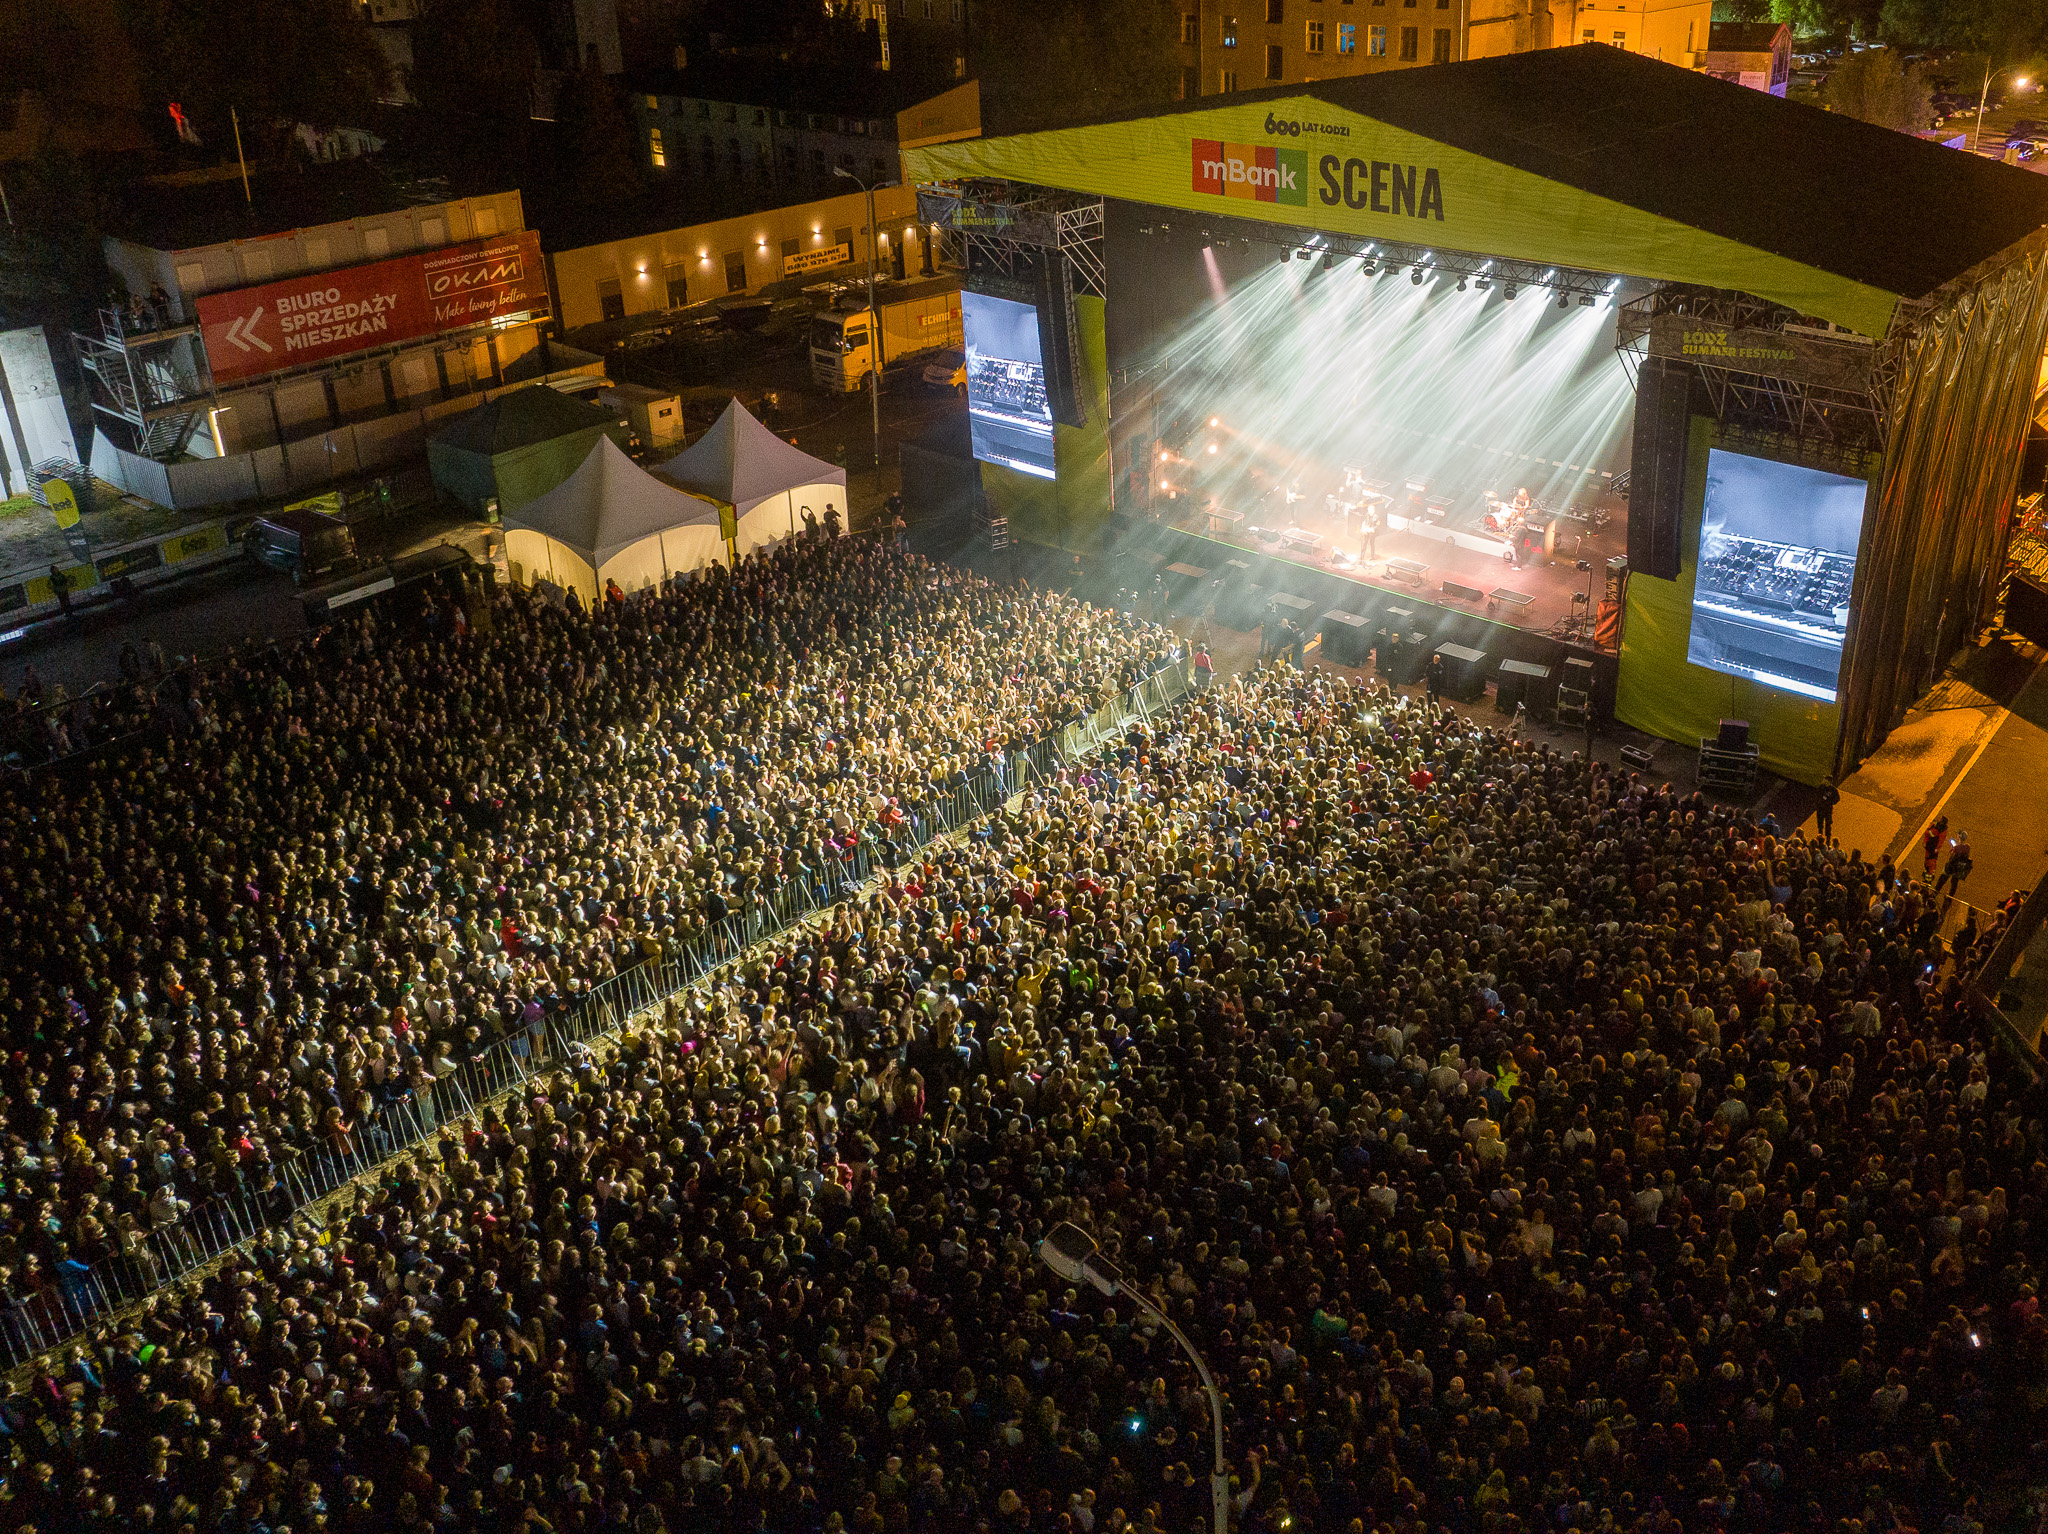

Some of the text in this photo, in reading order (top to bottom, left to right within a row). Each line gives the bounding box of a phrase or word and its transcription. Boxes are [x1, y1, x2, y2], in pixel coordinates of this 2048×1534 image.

[1264, 112, 1350, 137] 600 LAT ŁODZI
[1202, 154, 1445, 221] mBank SCENA
[952, 217, 1014, 226] SUMMER FESTIVAL
[423, 244, 519, 269] DOŚWIADCZONY DEWELOPER
[434, 261, 517, 292] OKAM
[276, 287, 340, 314] BIURO
[281, 293, 397, 332] SPRZEDAŻY
[435, 288, 527, 322] Make living better
[284, 312, 387, 351] MIESZKAŃ
[1682, 345, 1795, 360] SUMMER FESTIVAL
